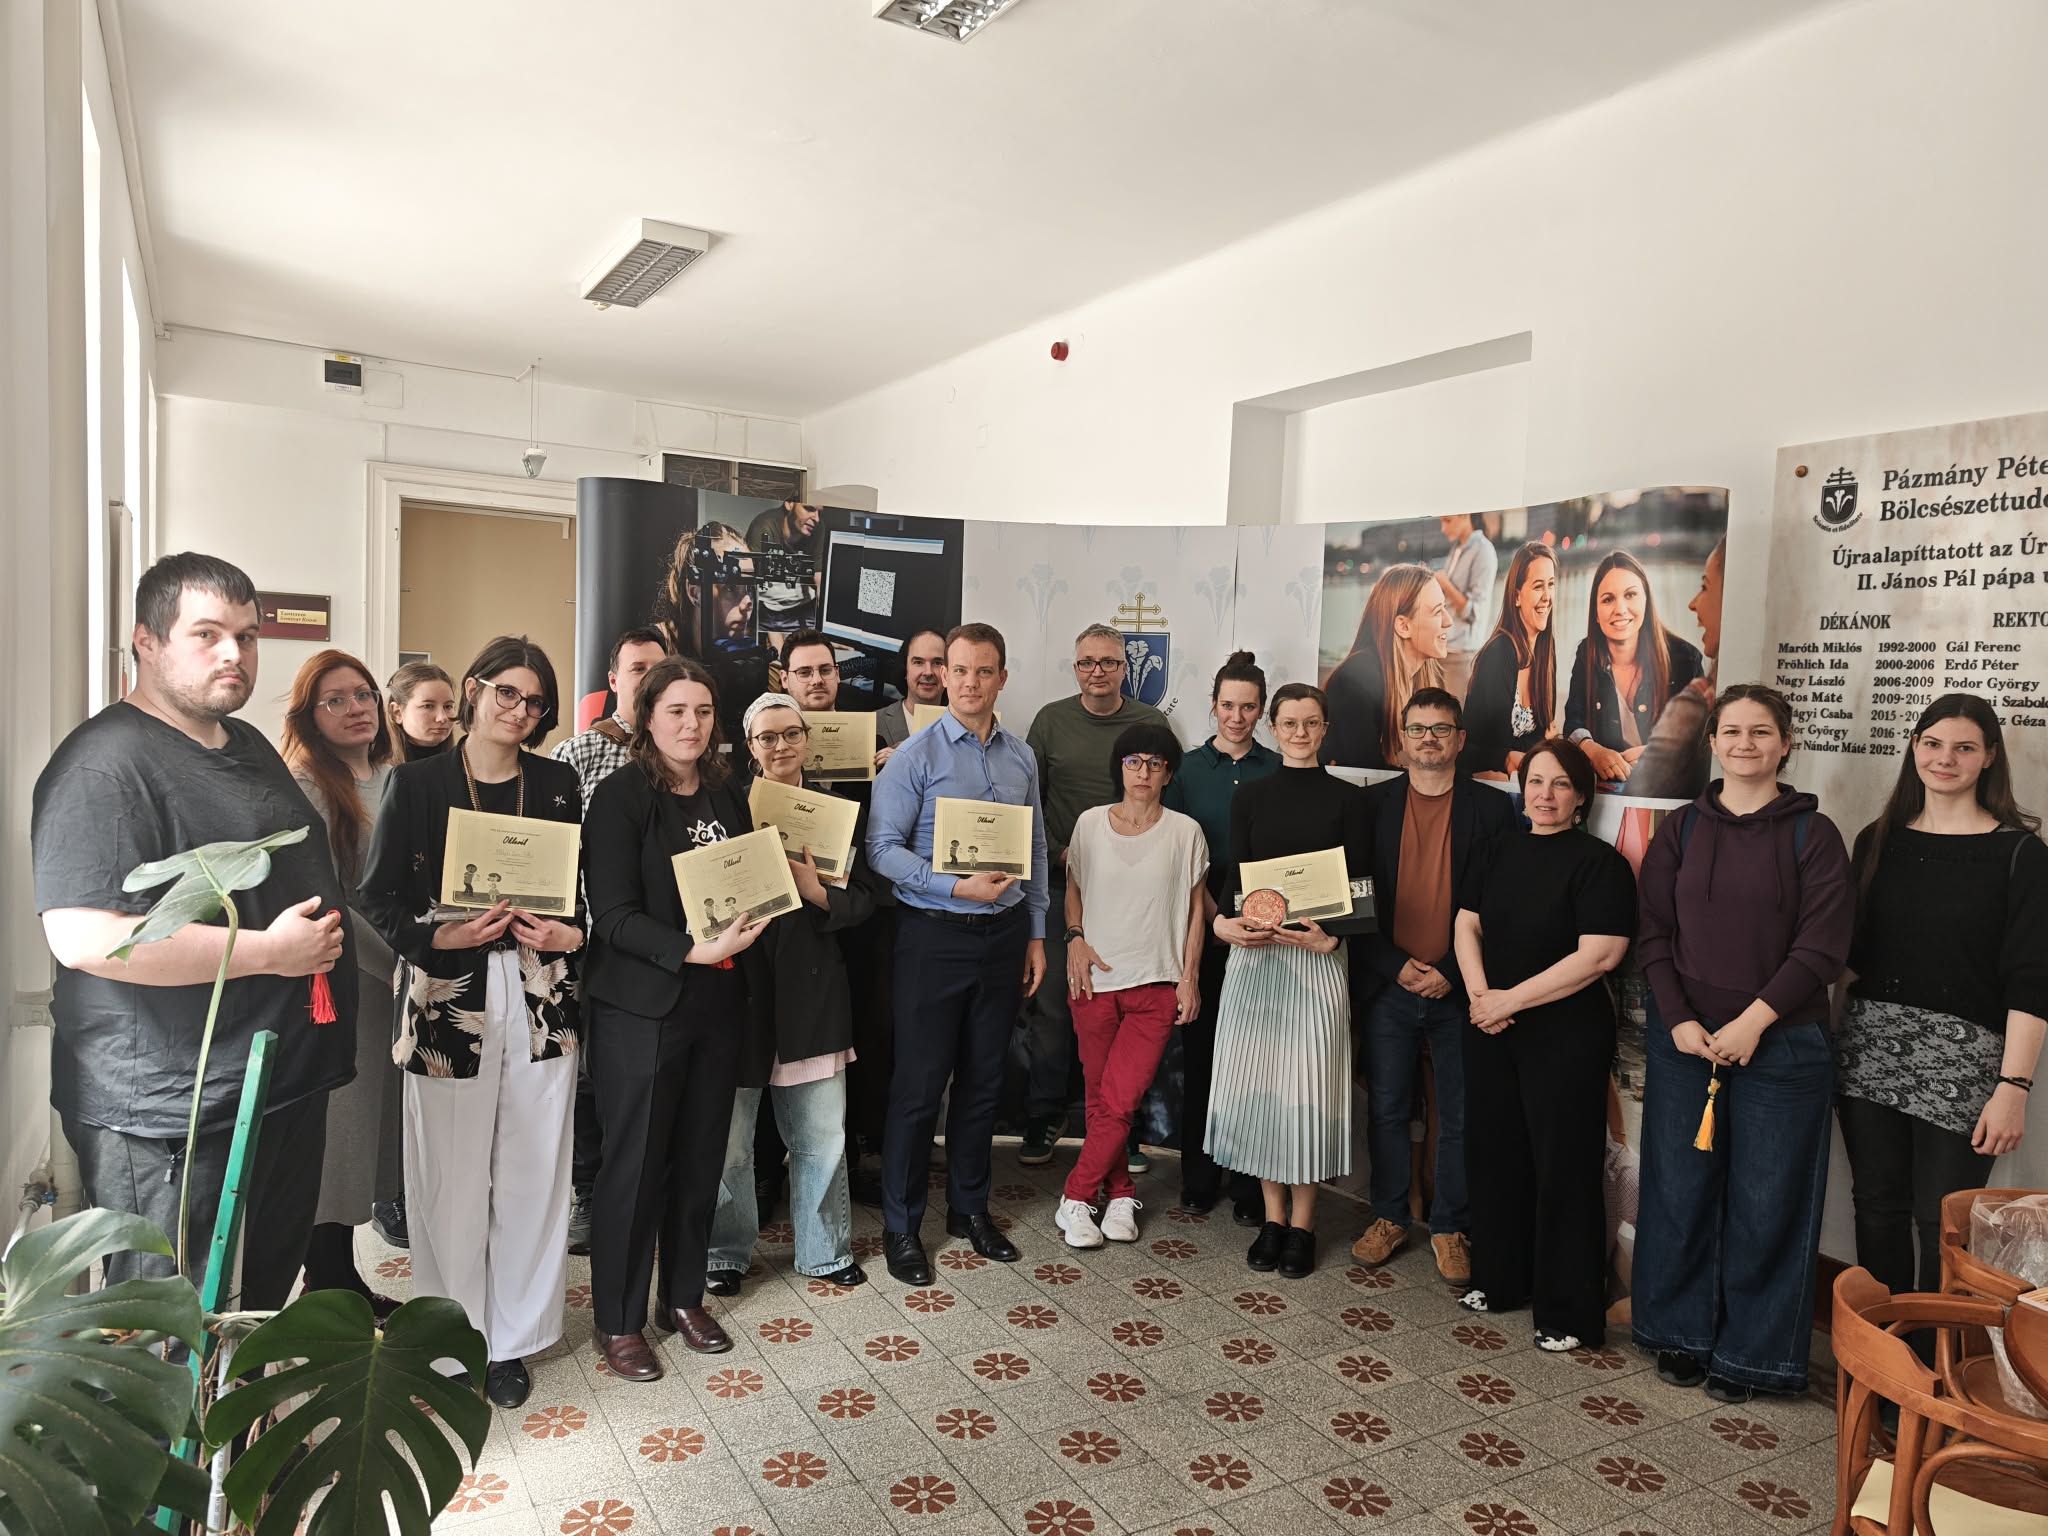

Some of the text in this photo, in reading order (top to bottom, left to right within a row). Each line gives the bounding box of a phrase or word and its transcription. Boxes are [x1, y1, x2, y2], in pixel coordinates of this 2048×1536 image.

[1882, 464, 1988, 491] Pázmány
[1832, 543, 1983, 569] Újraalapíttatott
[1989, 543, 2013, 558] az
[1857, 573, 1877, 591] II.
[1881, 572, 1938, 590] János
[1943, 568, 1976, 587] Pál
[1982, 567, 2035, 590] pápa
[1819, 612, 1892, 631] DÉKÁNOK
[1777, 641, 1937, 654] Maróth Miklós 1992-2000
[1945, 640, 2022, 653] Gál Ferenc
[1776, 658, 1935, 671] Fröhlich Ida 2000-2006
[1944, 658, 2020, 671] Erdő Péter
[1775, 675, 1934, 688] Nagy László 2006-2009
[1943, 676, 2040, 693] Fodor György
[1783, 691, 1932, 706] otos Máté 2009-2015
[1820, 707, 1853, 720] Csaba
[2011, 714, 2046, 727] Géza
[1807, 724, 1848, 742] György
[1803, 740, 1839, 752] Nándor
[1841, 742, 1867, 754] Máté
